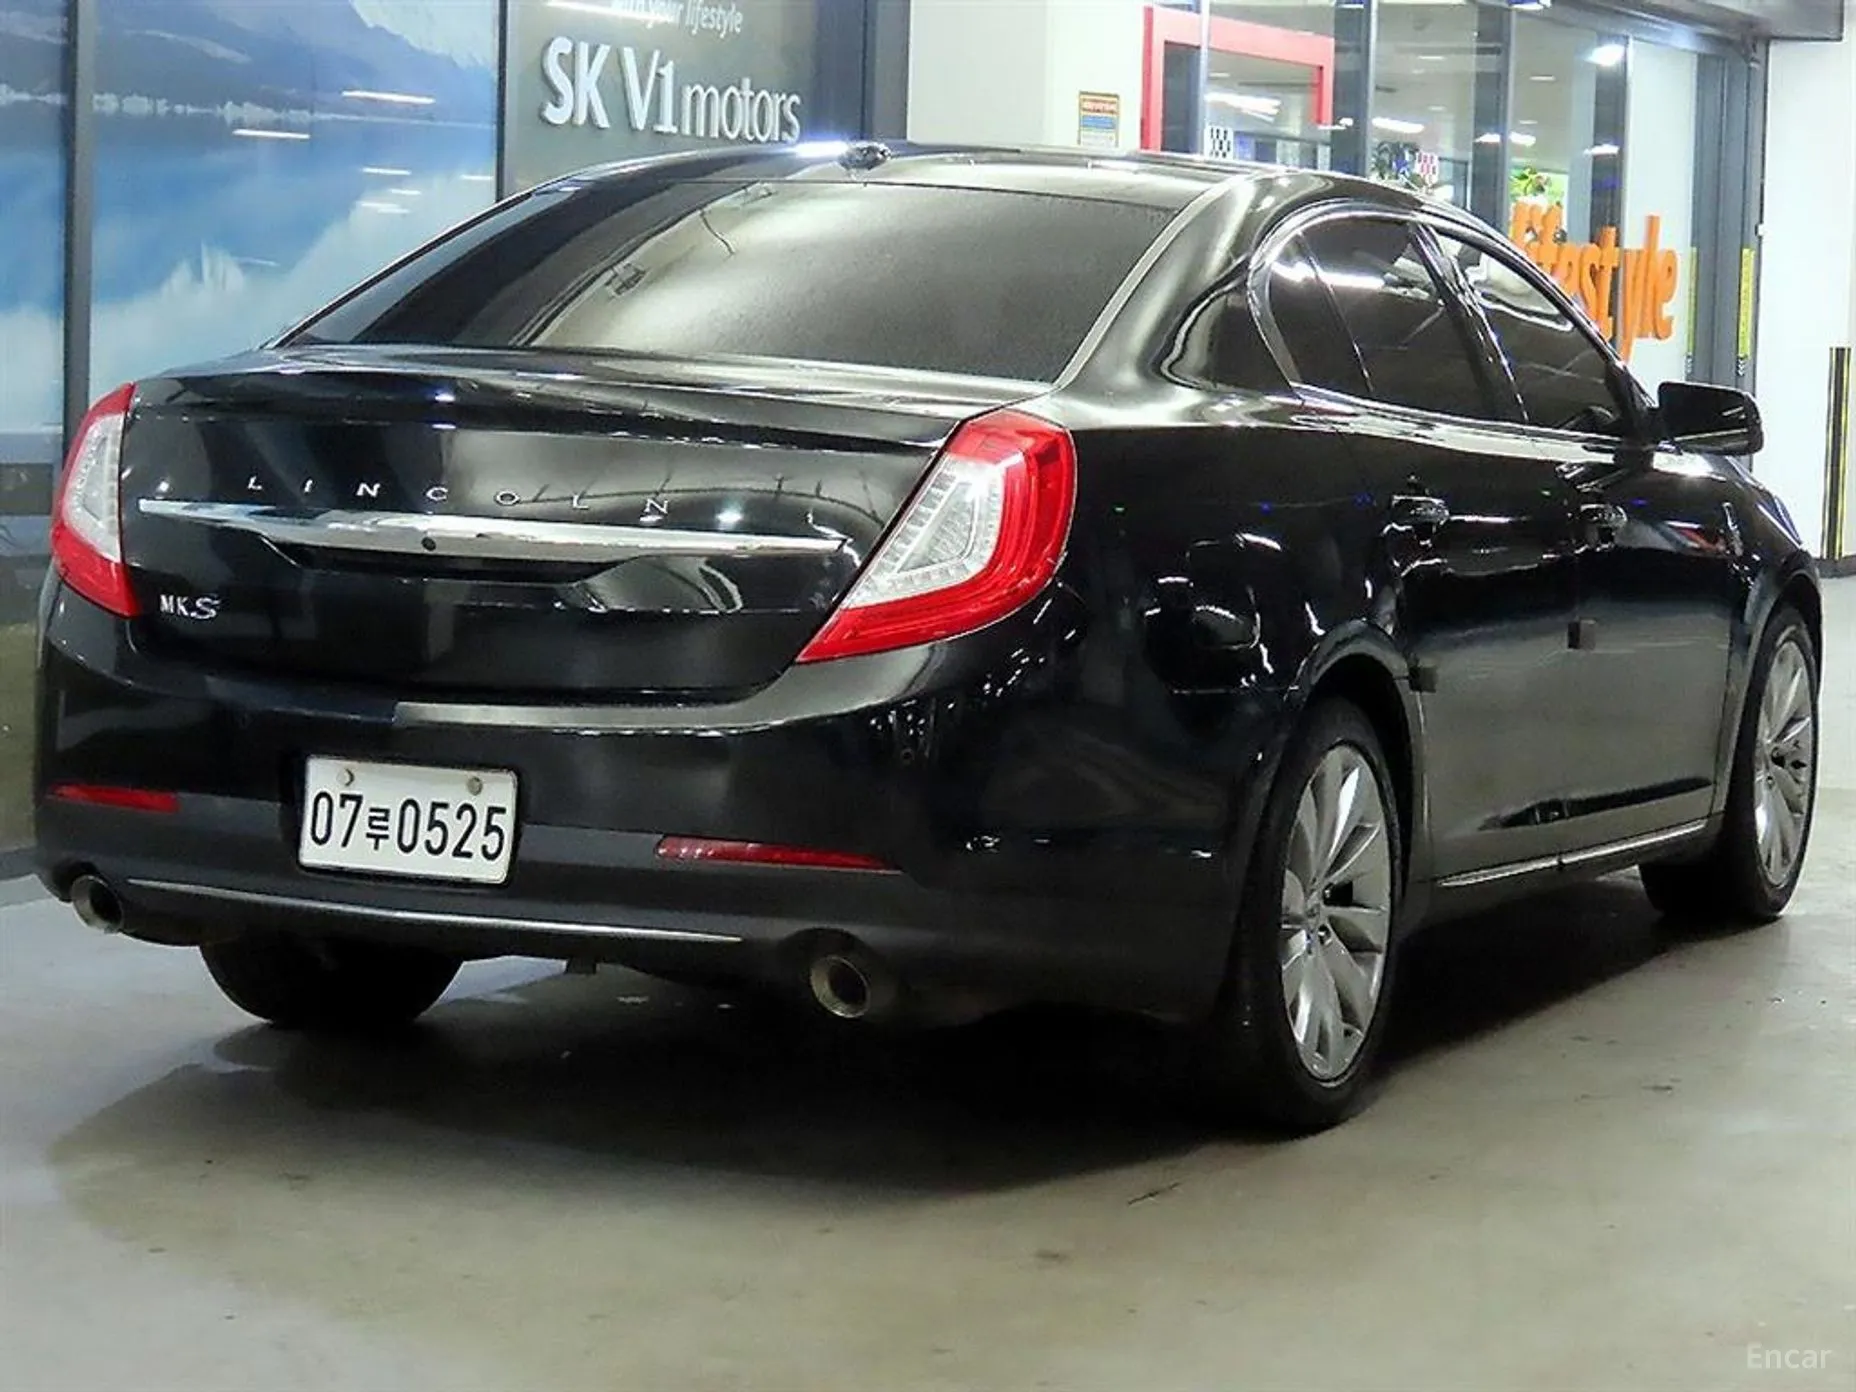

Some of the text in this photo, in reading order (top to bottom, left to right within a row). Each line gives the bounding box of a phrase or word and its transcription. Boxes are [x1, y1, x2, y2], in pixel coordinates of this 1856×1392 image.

[685, 0, 743, 38] lifestyle
[541, 36, 611, 129] SK
[247, 475, 669, 515] LINCOLN
[160, 594, 220, 619] MKS
[310, 791, 507, 861] 07루0525
